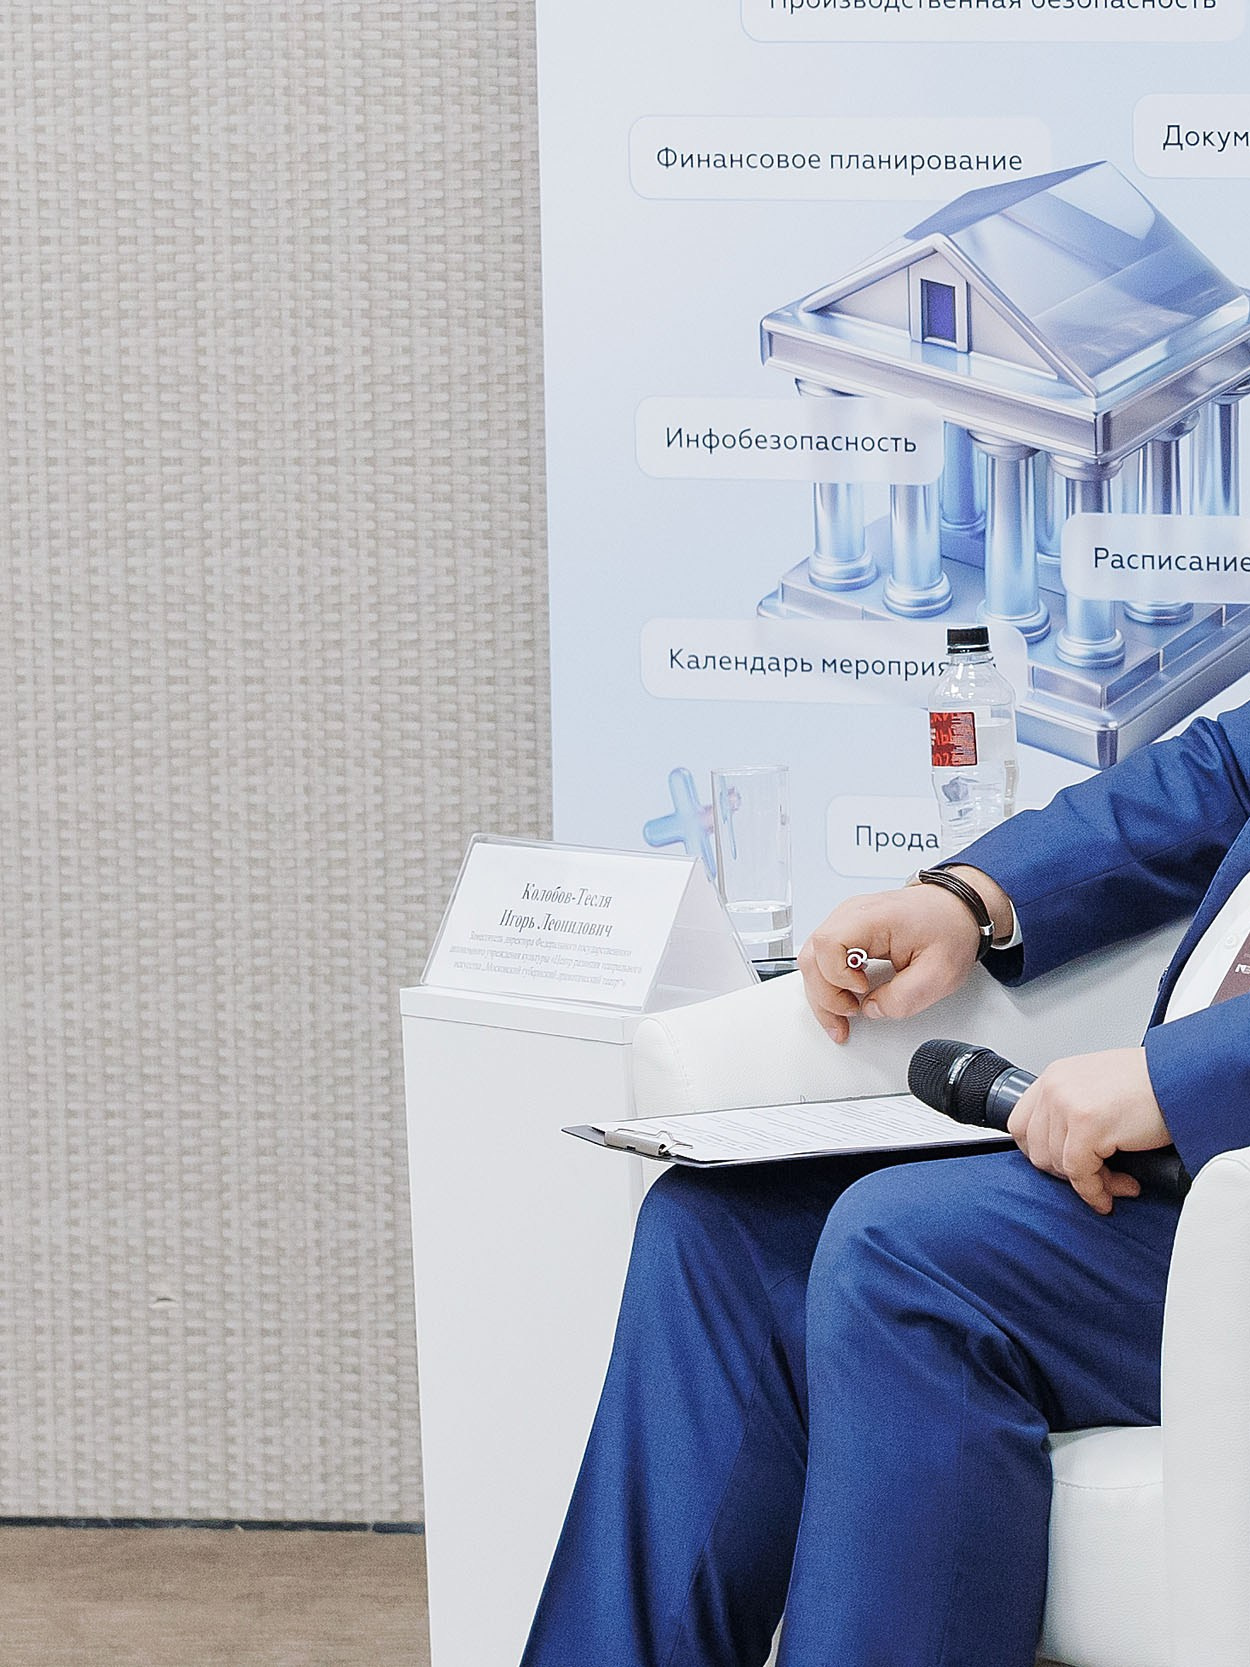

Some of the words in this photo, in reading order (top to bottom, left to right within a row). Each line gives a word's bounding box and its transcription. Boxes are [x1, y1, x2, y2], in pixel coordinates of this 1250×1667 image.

[656, 146, 821, 170] Финансовое
[830, 153, 1023, 177] планирование
[666, 427, 917, 454] Инфобезопасность
[670, 648, 813, 678] Календарь
[822, 656, 951, 683] мероприя
[856, 825, 940, 852] Прода
[520, 882, 613, 909] Колобов-Тесля
[499, 909, 536, 933] Игорь
[537, 912, 614, 938] Леонидович
